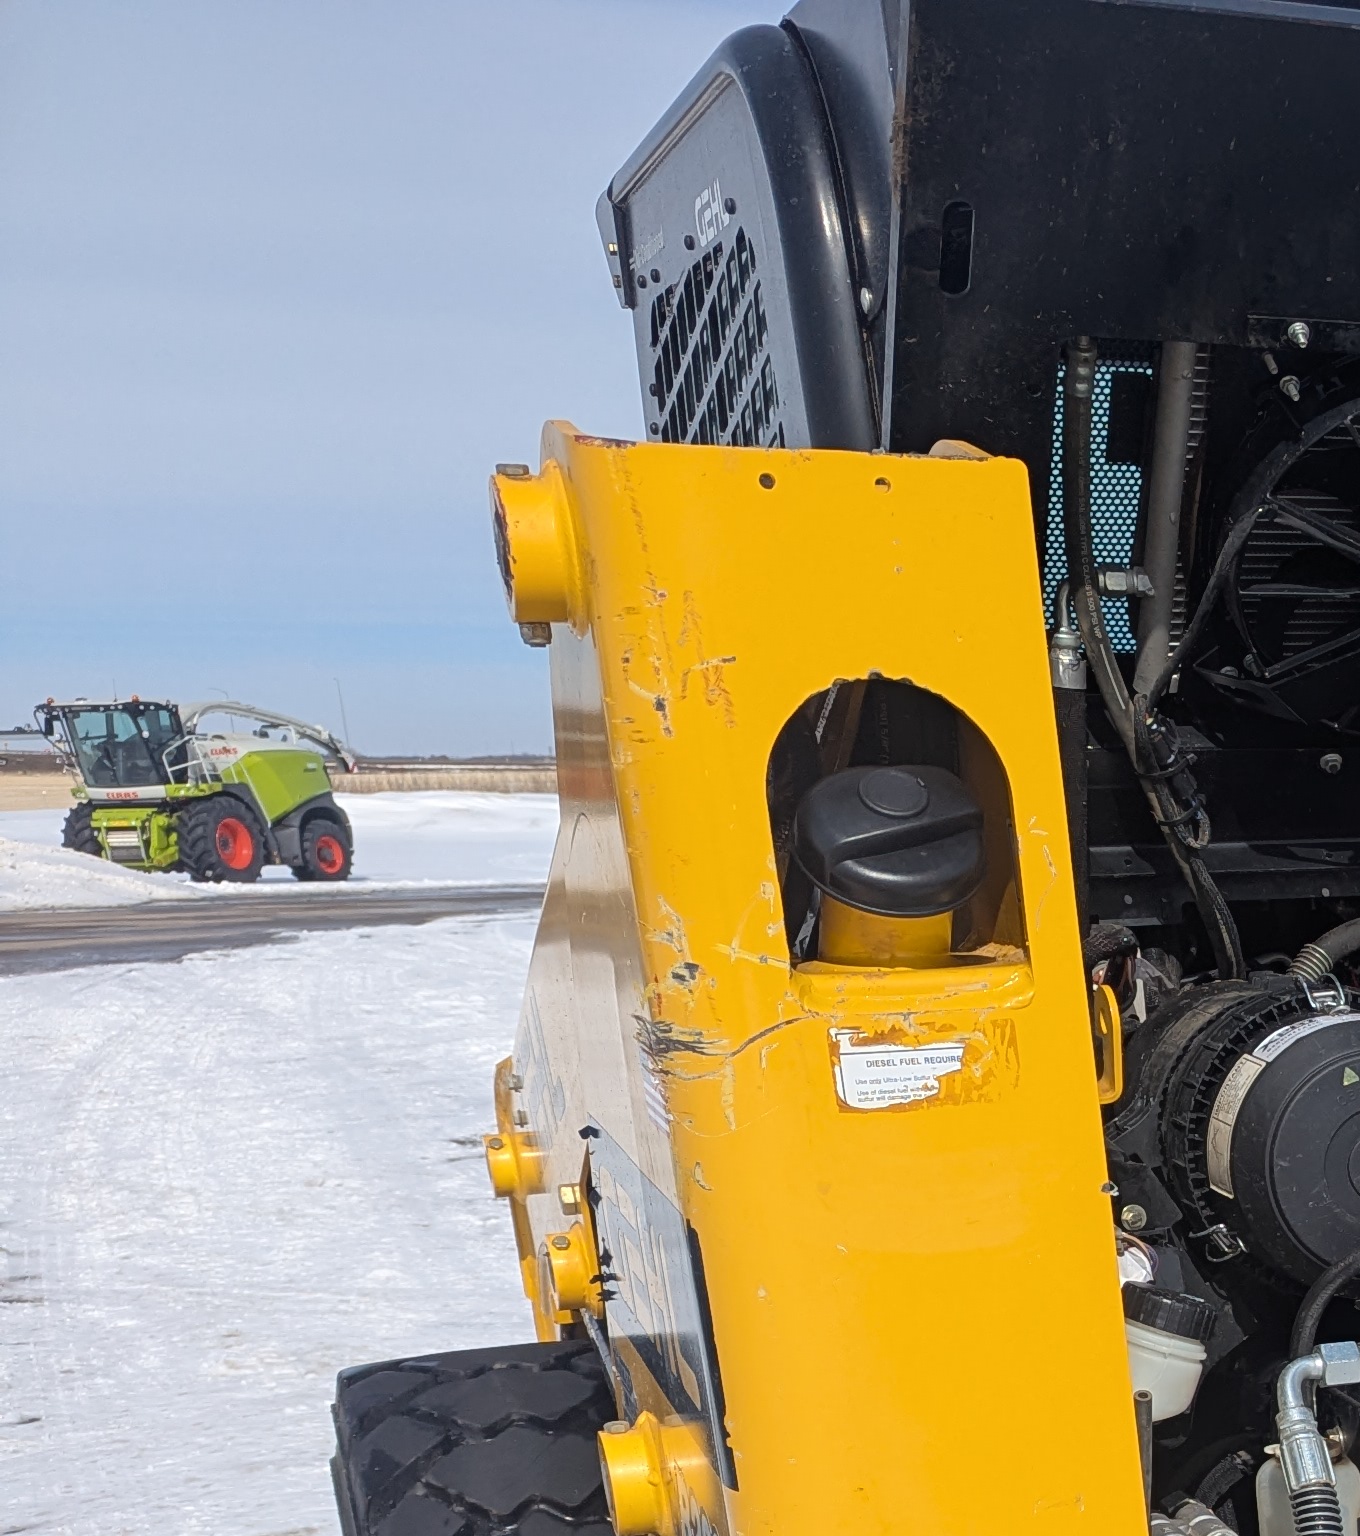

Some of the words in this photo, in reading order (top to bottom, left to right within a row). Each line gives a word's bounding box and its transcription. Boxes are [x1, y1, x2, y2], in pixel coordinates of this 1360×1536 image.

[694, 178, 730, 248] GEHL
[866, 1059, 897, 1068] DIESEL
[899, 1057, 921, 1066] FUEL
[869, 1078, 882, 1086] only
[878, 1087, 897, 1095] diesel
[897, 1086, 909, 1094] fuel
[887, 1093, 911, 1101] damage
